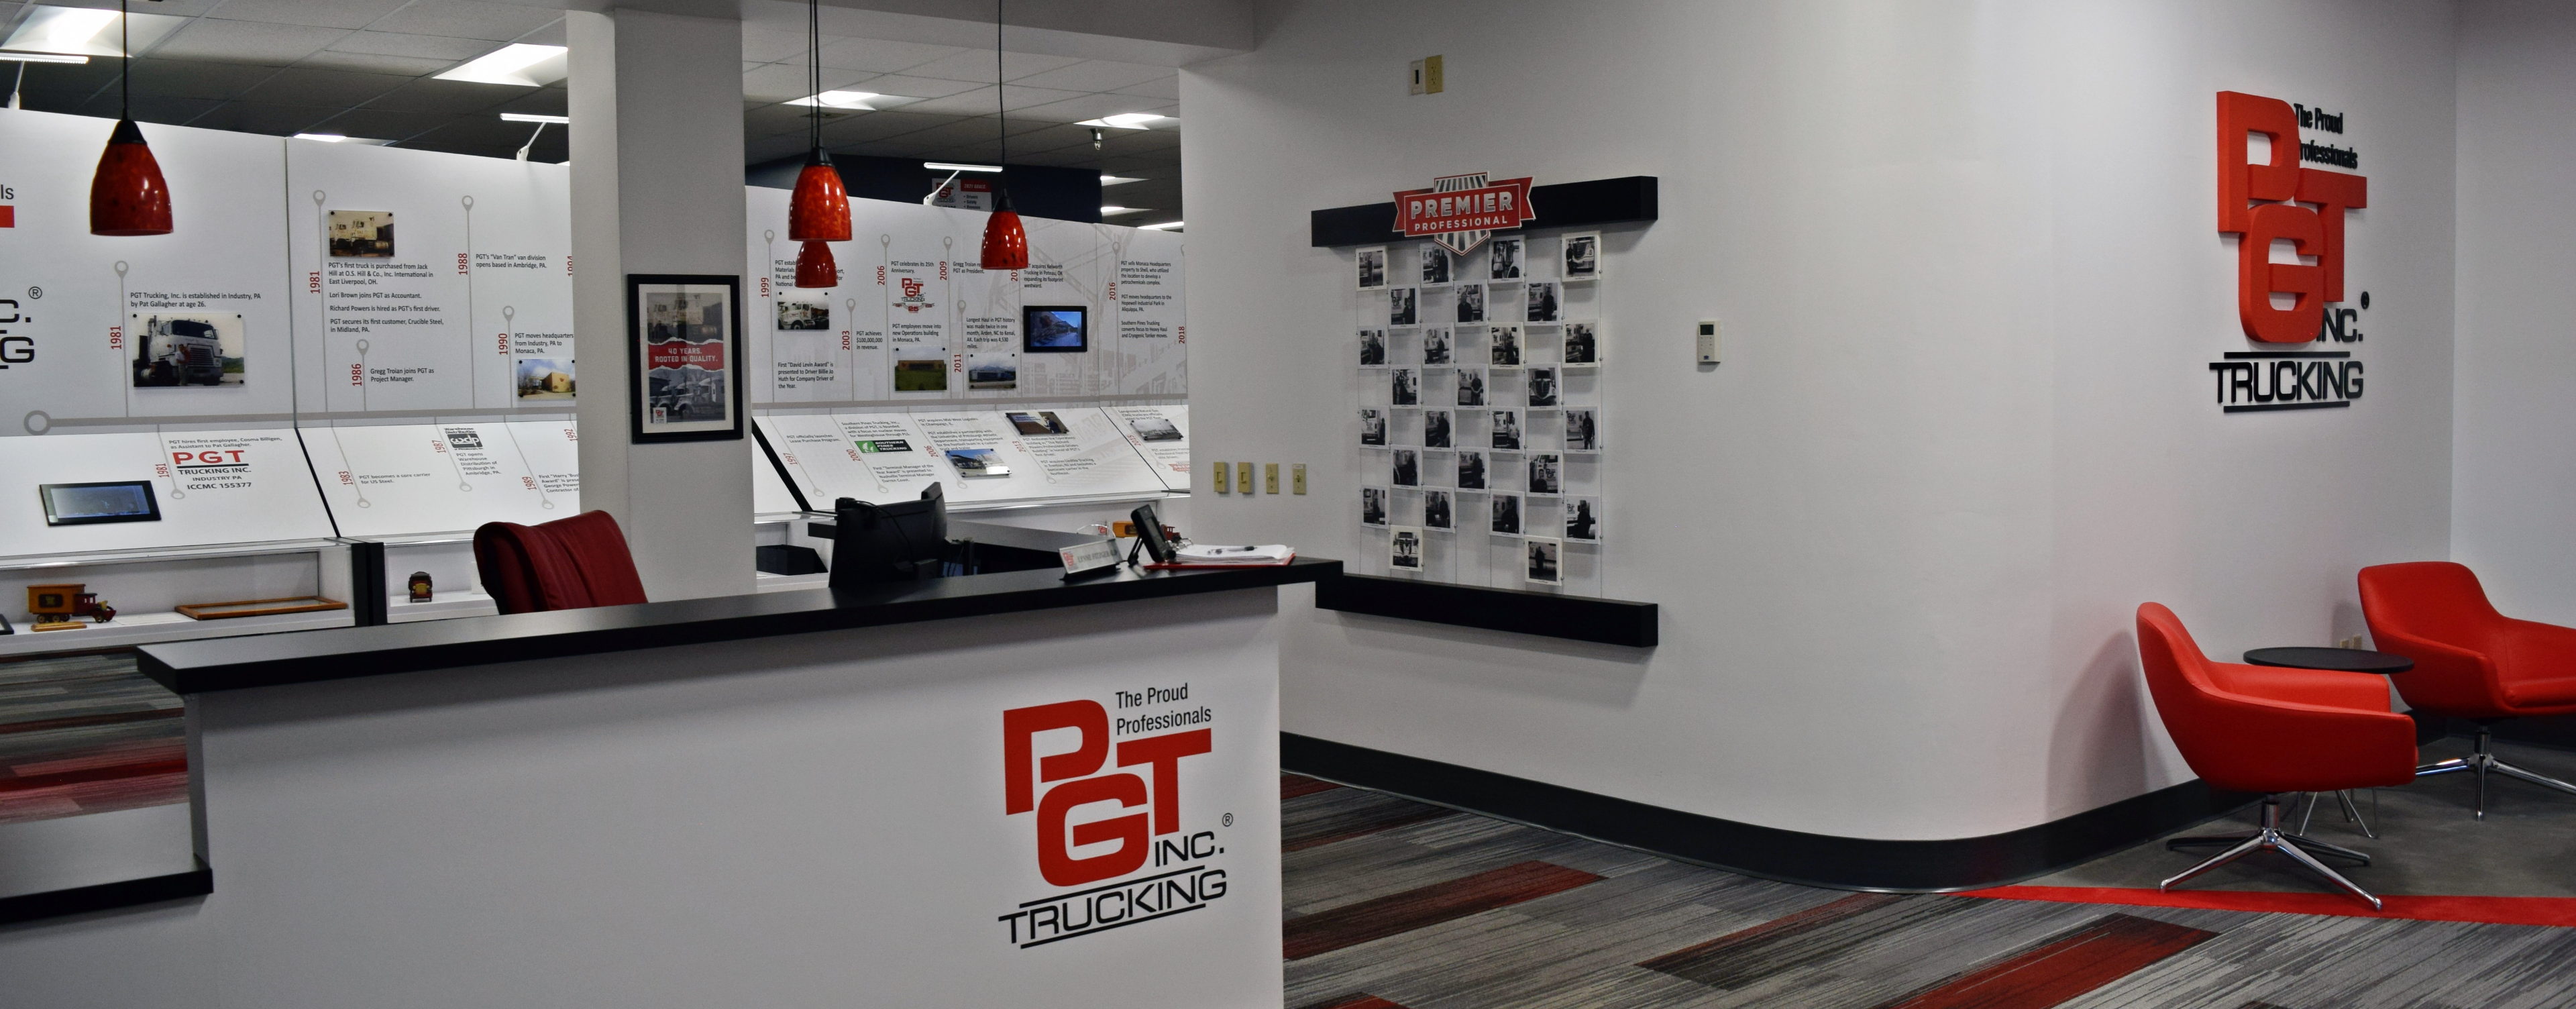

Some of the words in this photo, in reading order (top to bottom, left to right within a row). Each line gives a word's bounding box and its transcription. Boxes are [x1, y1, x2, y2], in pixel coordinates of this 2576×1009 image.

[2293, 103, 2313, 128] The
[2315, 107, 2343, 134] Proud
[2299, 139, 2358, 169] rofessionals
[1410, 191, 1514, 220] PREMIER
[1414, 216, 1508, 231] PROFESSIONAL
[458, 253, 468, 275] 1988
[310, 271, 320, 294] 1981
[877, 265, 885, 286] 2006
[143, 292, 170, 300] Trucking,
[761, 277, 769, 298] 1999
[130, 300, 138, 308] by
[149, 300, 178, 309] Gallagher
[2316, 308, 2363, 342] NC.
[110, 326, 122, 350] 1981
[498, 333, 508, 355] 1990
[842, 330, 850, 350] 2003
[351, 363, 362, 386] 1986
[2209, 361, 2364, 403] TRUCKING
[564, 429, 578, 441] 1992
[172, 450, 245, 465] PGT
[432, 440, 446, 454] 1987
[155, 463, 170, 478] 1981
[338, 471, 353, 486] 1983
[522, 476, 537, 490] 1989
[1115, 690, 1142, 709] The
[1147, 682, 1188, 705] Proud
[1116, 706, 1212, 735] Professionals
[1003, 699, 1212, 887] PGT
[1155, 831, 1225, 867] INC.
[998, 869, 1227, 944] TRUCKING
